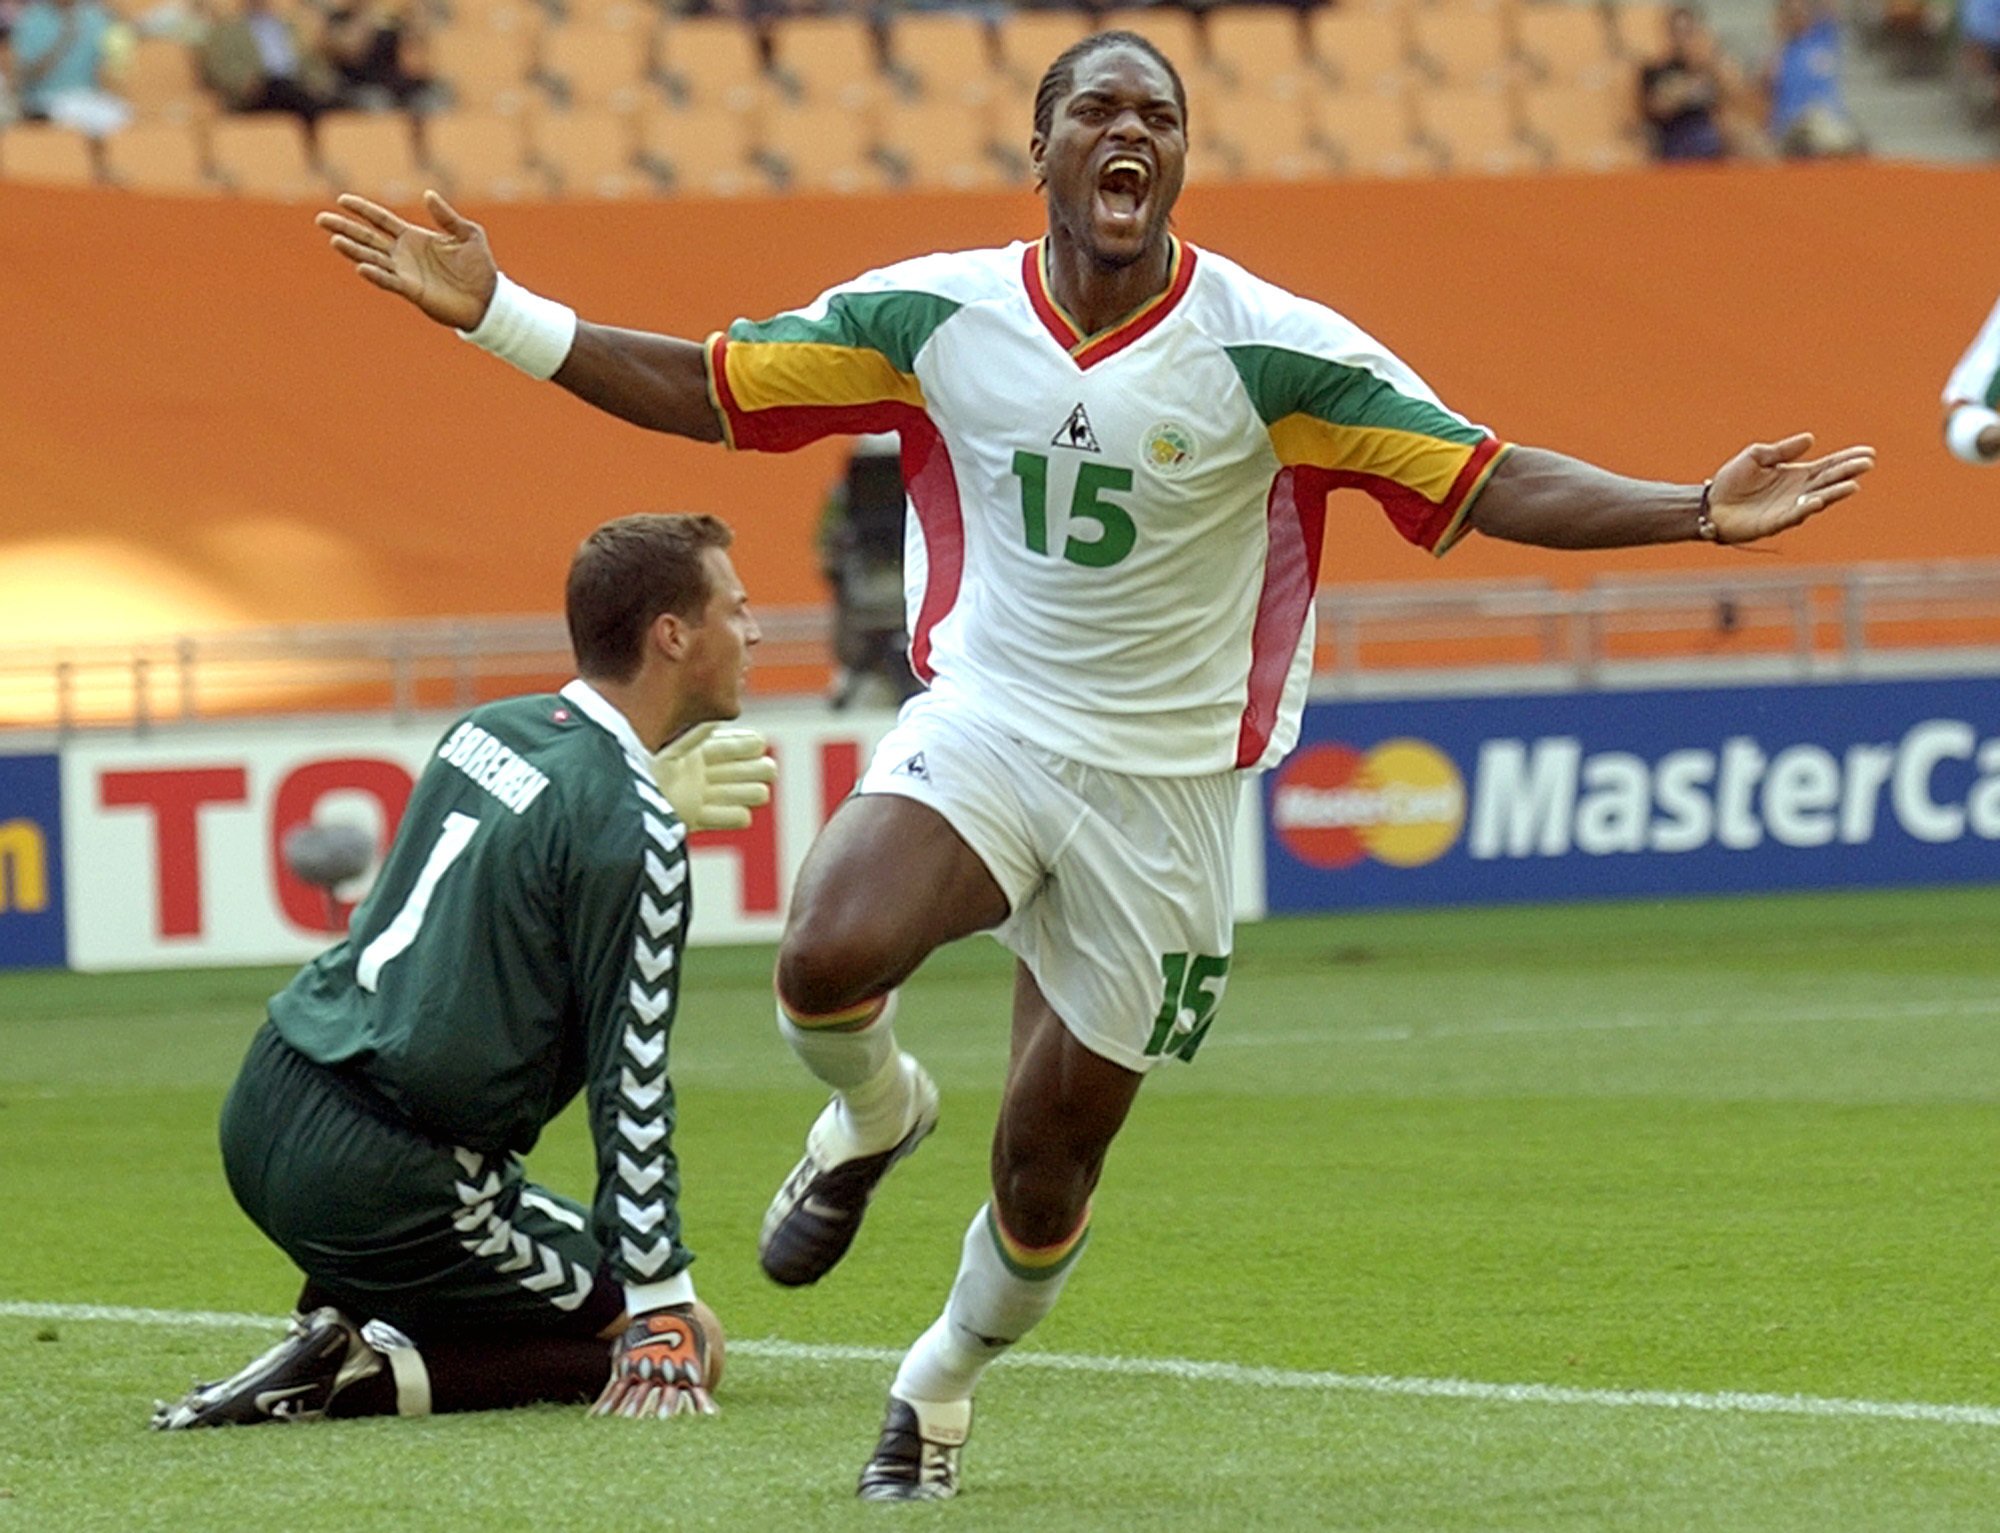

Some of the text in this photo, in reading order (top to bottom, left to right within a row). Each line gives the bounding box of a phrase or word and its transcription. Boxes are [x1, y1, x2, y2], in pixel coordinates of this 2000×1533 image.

[1012, 450, 1136, 568] 15
[356, 811, 480, 993] 1
[1144, 952, 1230, 1064] 15
